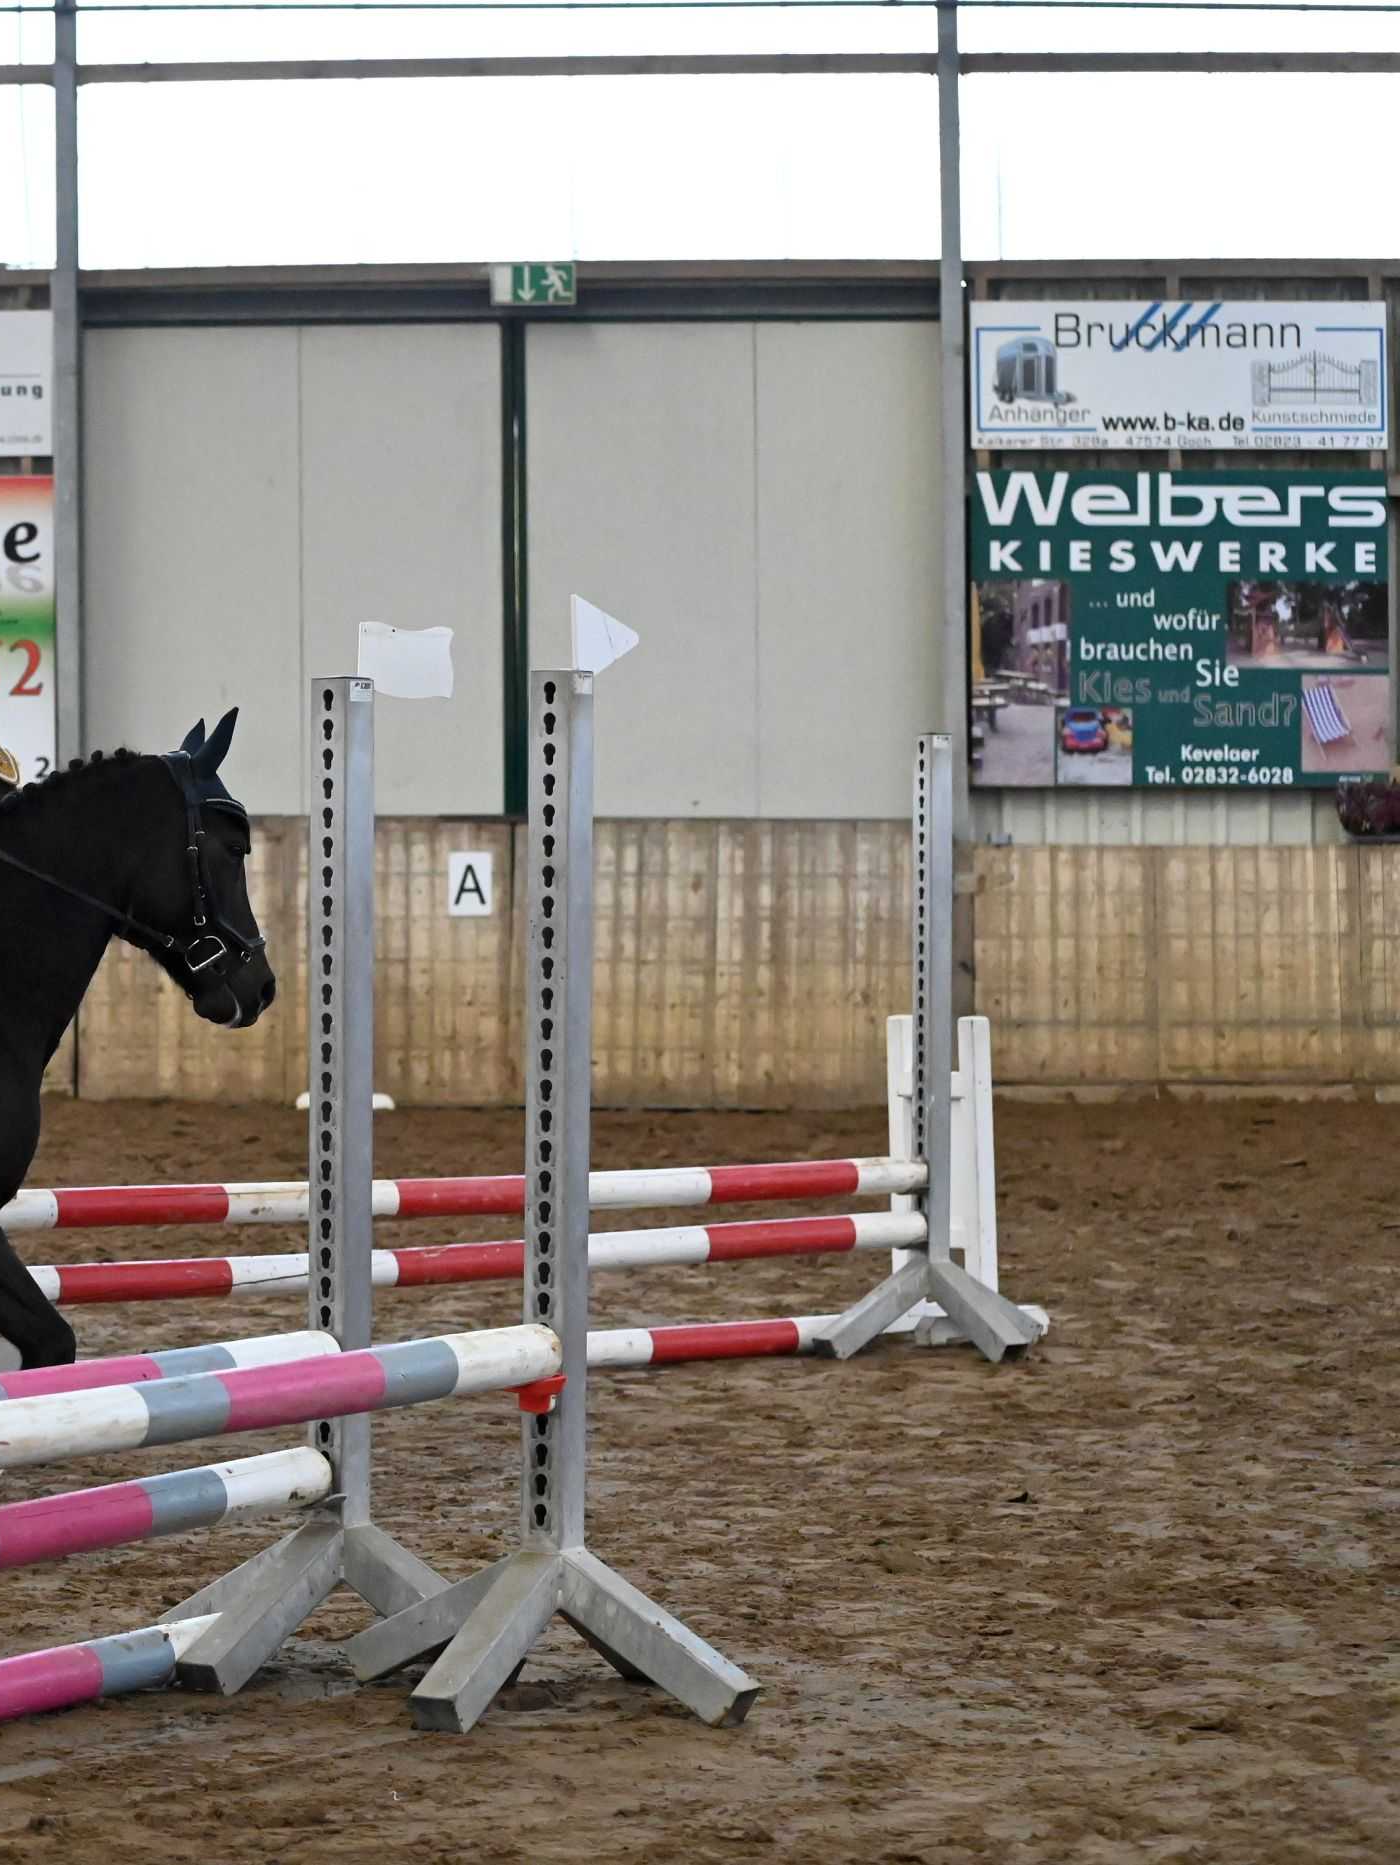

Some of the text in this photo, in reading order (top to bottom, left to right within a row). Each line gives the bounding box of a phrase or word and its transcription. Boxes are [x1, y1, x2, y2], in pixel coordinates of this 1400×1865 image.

[1054, 312, 1302, 350] Bruckmann
[1102, 411, 1245, 432] www.b-ka.de
[1251, 408, 1377, 425] Kunstschmiede
[974, 471, 1388, 527] Welbers
[987, 538, 1378, 574] KIESWERKE
[1116, 588, 1156, 609] und
[1153, 607, 1222, 631] wofür
[1079, 636, 1194, 661] brauchen
[1195, 658, 1240, 687] Sie
[1078, 670, 1298, 728] Kies und Sand?
[1180, 743, 1260, 763] Kevelaer
[1144, 766, 1294, 785] Tel. 02832-6028
[454, 864, 486, 905] A
